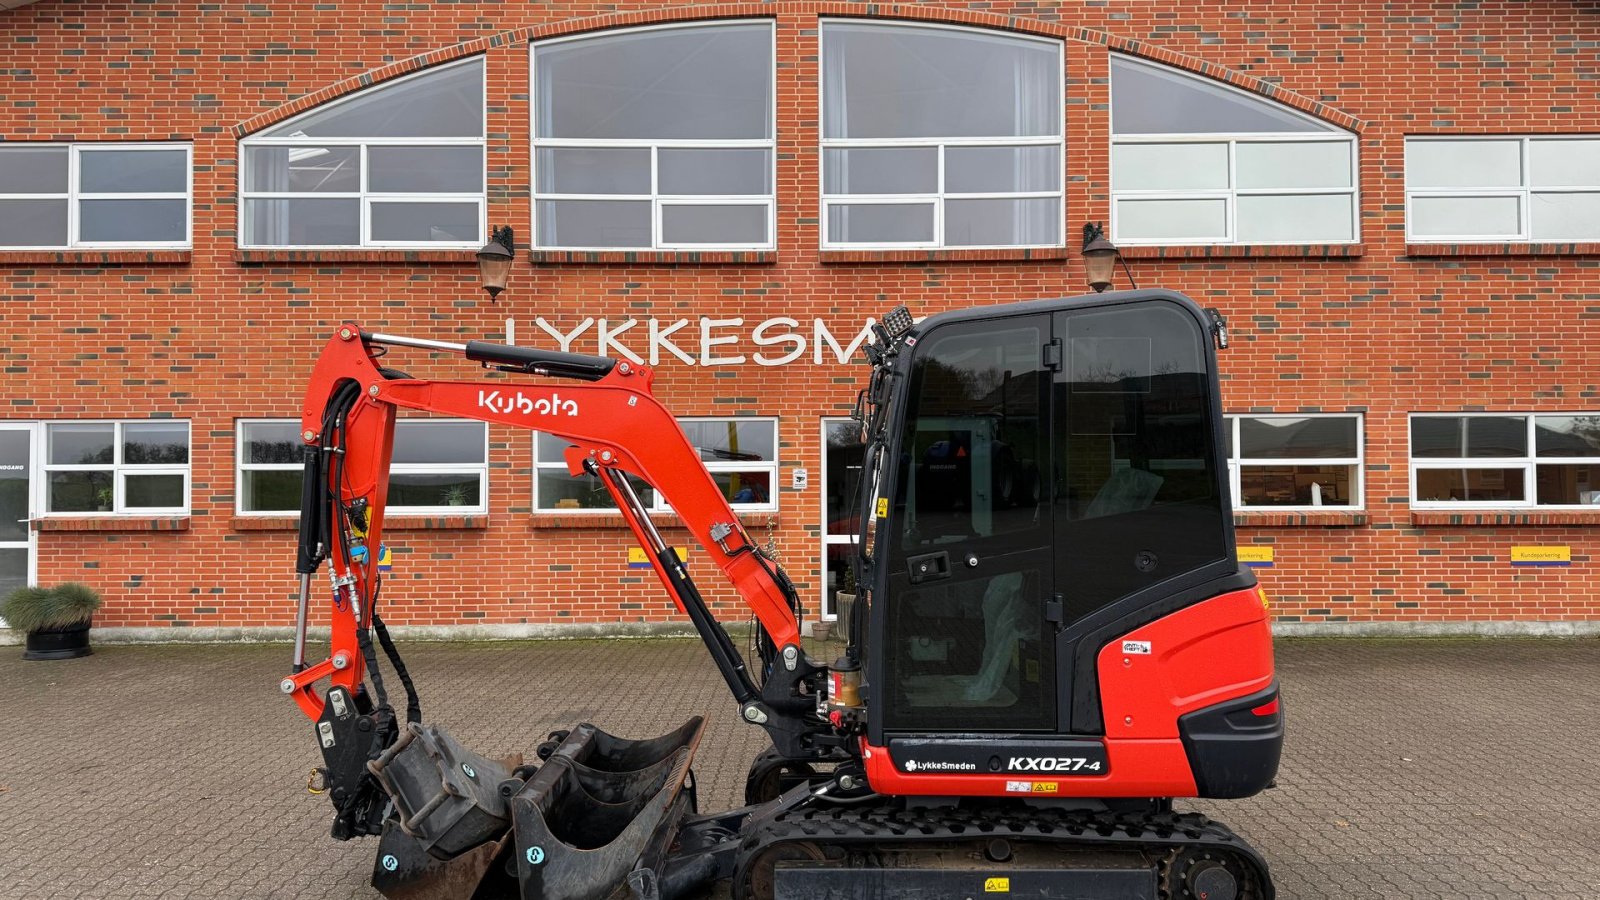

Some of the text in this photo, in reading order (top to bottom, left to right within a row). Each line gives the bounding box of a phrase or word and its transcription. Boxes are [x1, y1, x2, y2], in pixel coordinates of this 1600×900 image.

[505, 316, 927, 366] YKKESM
[478, 390, 578, 416] Kubota
[917, 762, 976, 770] LykkeSmeden
[1008, 757, 1101, 771] KX027-4
